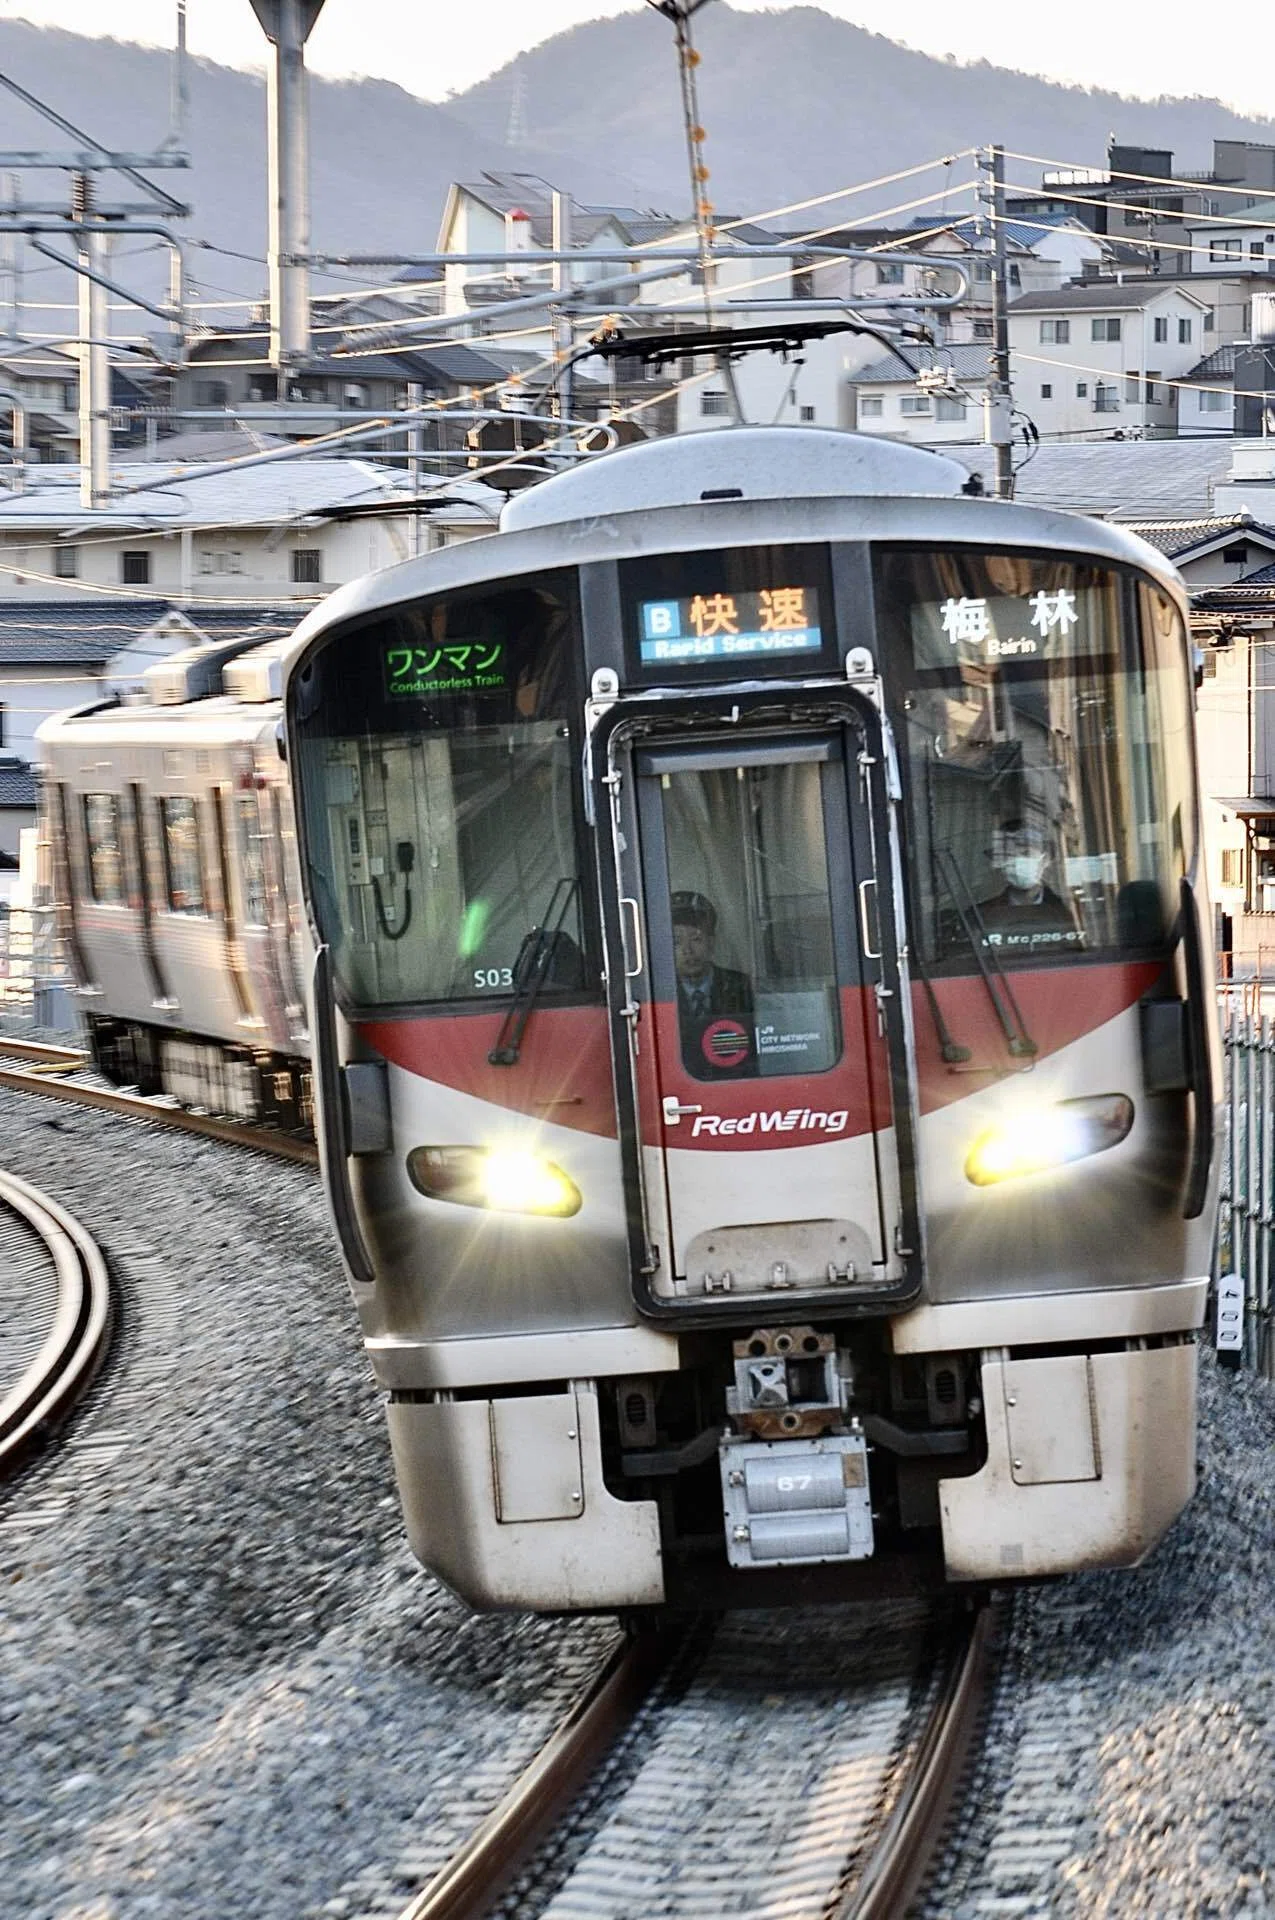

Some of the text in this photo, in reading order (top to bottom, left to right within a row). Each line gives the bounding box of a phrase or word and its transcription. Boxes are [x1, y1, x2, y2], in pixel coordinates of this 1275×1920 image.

[651, 608, 671, 633] B
[690, 587, 808, 636] 快速
[940, 588, 1079, 644] 梅林
[722, 632, 807, 650] Service
[987, 636, 1037, 656] Bairin
[388, 644, 501, 677] ワンマン
[390, 674, 504, 693] Conductorless Train
[473, 968, 513, 988] S03
[761, 1032, 821, 1045] CITY NETWORK
[777, 1475, 813, 1491] 67
